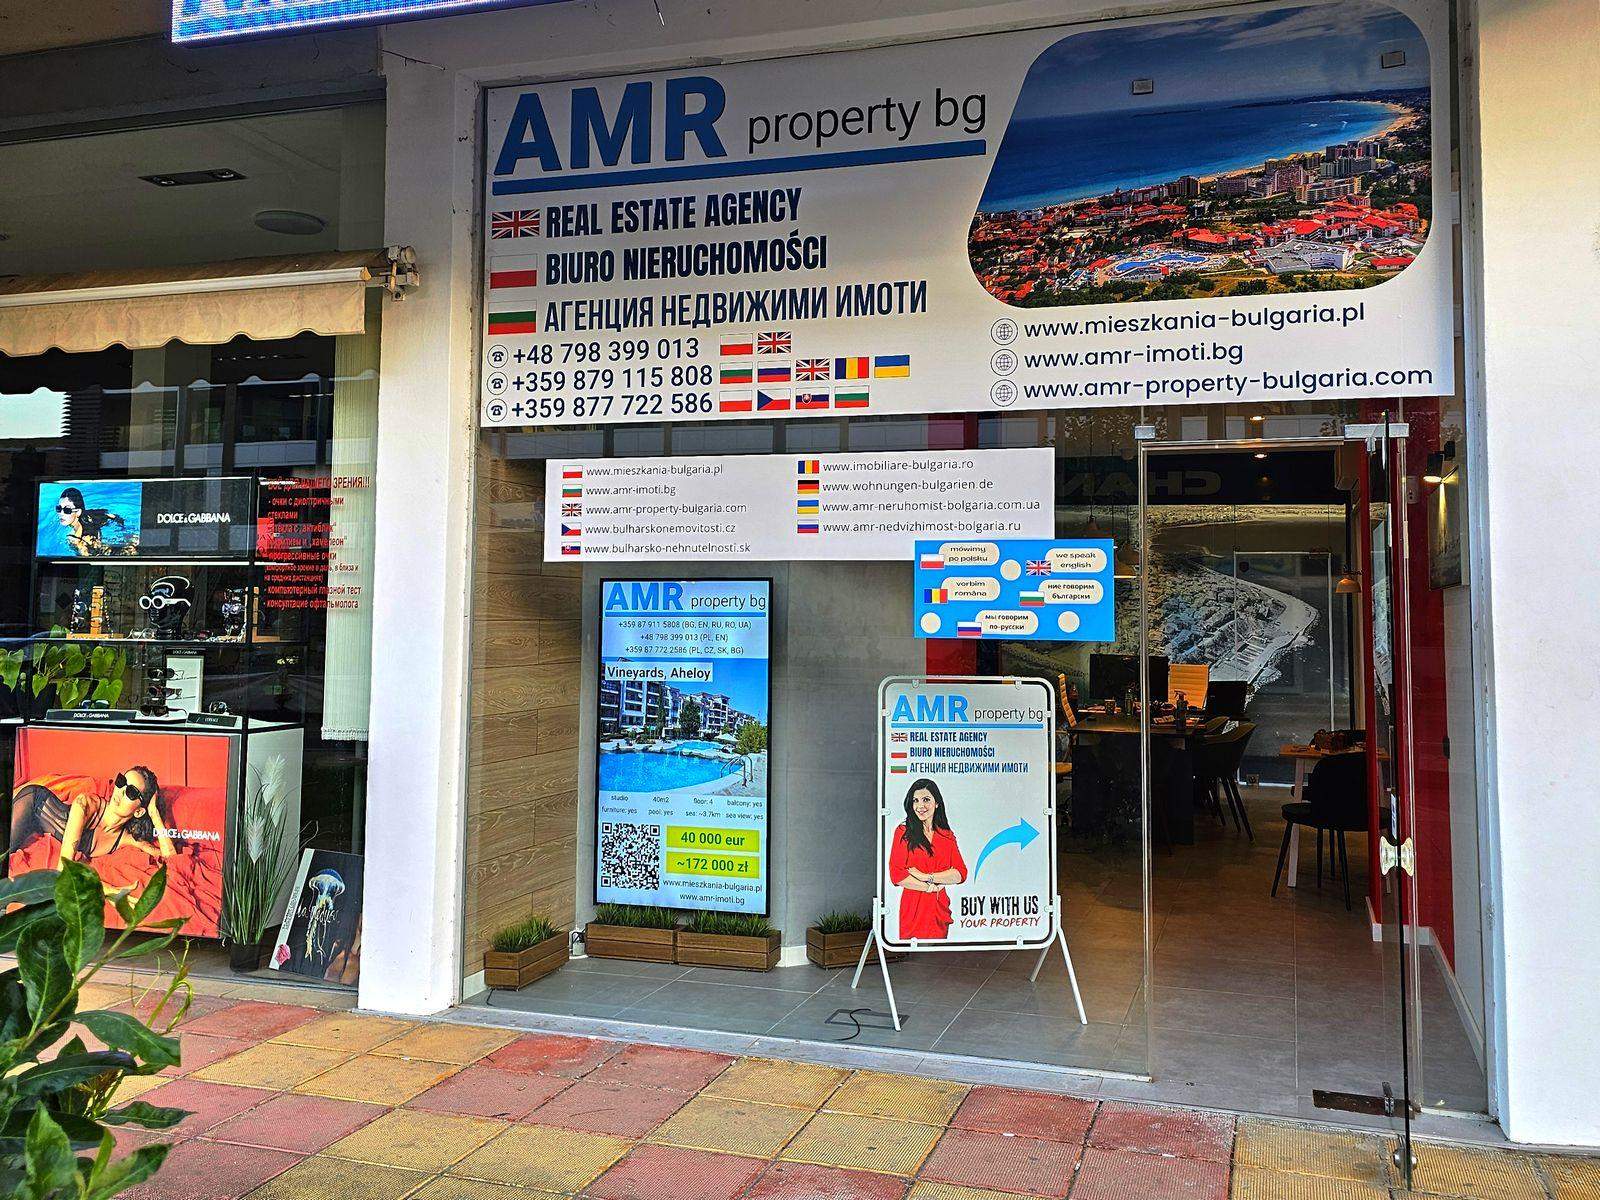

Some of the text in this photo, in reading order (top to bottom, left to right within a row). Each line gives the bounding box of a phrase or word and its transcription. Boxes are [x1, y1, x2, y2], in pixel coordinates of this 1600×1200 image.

[493, 75, 987, 177] AMR property bg
[545, 187, 802, 239] REAL ESTATE AGENCY
[545, 229, 828, 286] BIURO NIERUCHOMOŚCI
[544, 280, 927, 333] АГЕНЦИЯ НЕДВИЖИМИ ИМОТИ
[1023, 302, 1365, 338] www.mieszkania-bulgaria.pl
[513, 337, 700, 365] +48 798 399 013
[1023, 342, 1244, 370] www.amr-imoti.bg
[512, 364, 713, 393] +359 879 115 808
[1023, 366, 1433, 400] www.amr-property-bulgaria.com
[511, 392, 713, 419] +359 877 722 586
[586, 464, 723, 477] www.mieszkania-bulgaria.pl
[823, 459, 974, 472] www.imobiliare-bulgaria.ro
[333, 476, 370, 489] ЗРЕНИЯ!!!
[822, 479, 994, 492] www.wohnungen-bulgarien.de
[586, 485, 676, 496] www.amr-imoti.bg
[271, 497, 288, 506] очки
[822, 500, 1040, 513] www.amr-neruhomist-bolgaria.com.ua
[586, 503, 747, 515] www.amr-property-bulgaria.com
[585, 524, 736, 534] www.bulharskonemovitosti.cz
[823, 520, 1022, 533] www.amr-nedvizhimost-bolgaria.ru
[584, 542, 751, 553] www.bulharsko-nehnutelnosti.sk
[960, 555, 988, 563] polsku
[1070, 552, 1096, 560] speak
[1060, 561, 1092, 570] english
[346, 587, 362, 595] тест
[605, 582, 766, 611] AMR property bg
[1052, 592, 1091, 600] български
[663, 621, 680, 629] 5808
[989, 623, 1025, 631] по-русски
[685, 634, 698, 642] 013
[715, 634, 728, 642] EN)
[644, 646, 653, 654] 87
[655, 646, 668, 654] 772
[669, 646, 687, 654] 2586
[607, 666, 711, 680] Vineyards, Aheloy
[891, 694, 1044, 722] AMR property bg
[909, 732, 988, 742] REAL ESTATE AGENCY
[909, 746, 995, 758] BIURO NIERUCHOMOŚCI
[909, 762, 1029, 774] АГЕНЦИЯ НЕДВИЖИМИ ИМОТИ
[680, 831, 745, 846] 40 000 eur
[676, 858, 749, 872] ~172 000 zł
[663, 879, 763, 894] www.mieszkania-bulgaria.pl
[679, 893, 745, 906] www.amr-imoti.bg
[960, 895, 1039, 916] BUY WITH US
[959, 915, 1041, 928] YOUR PROPERTY
